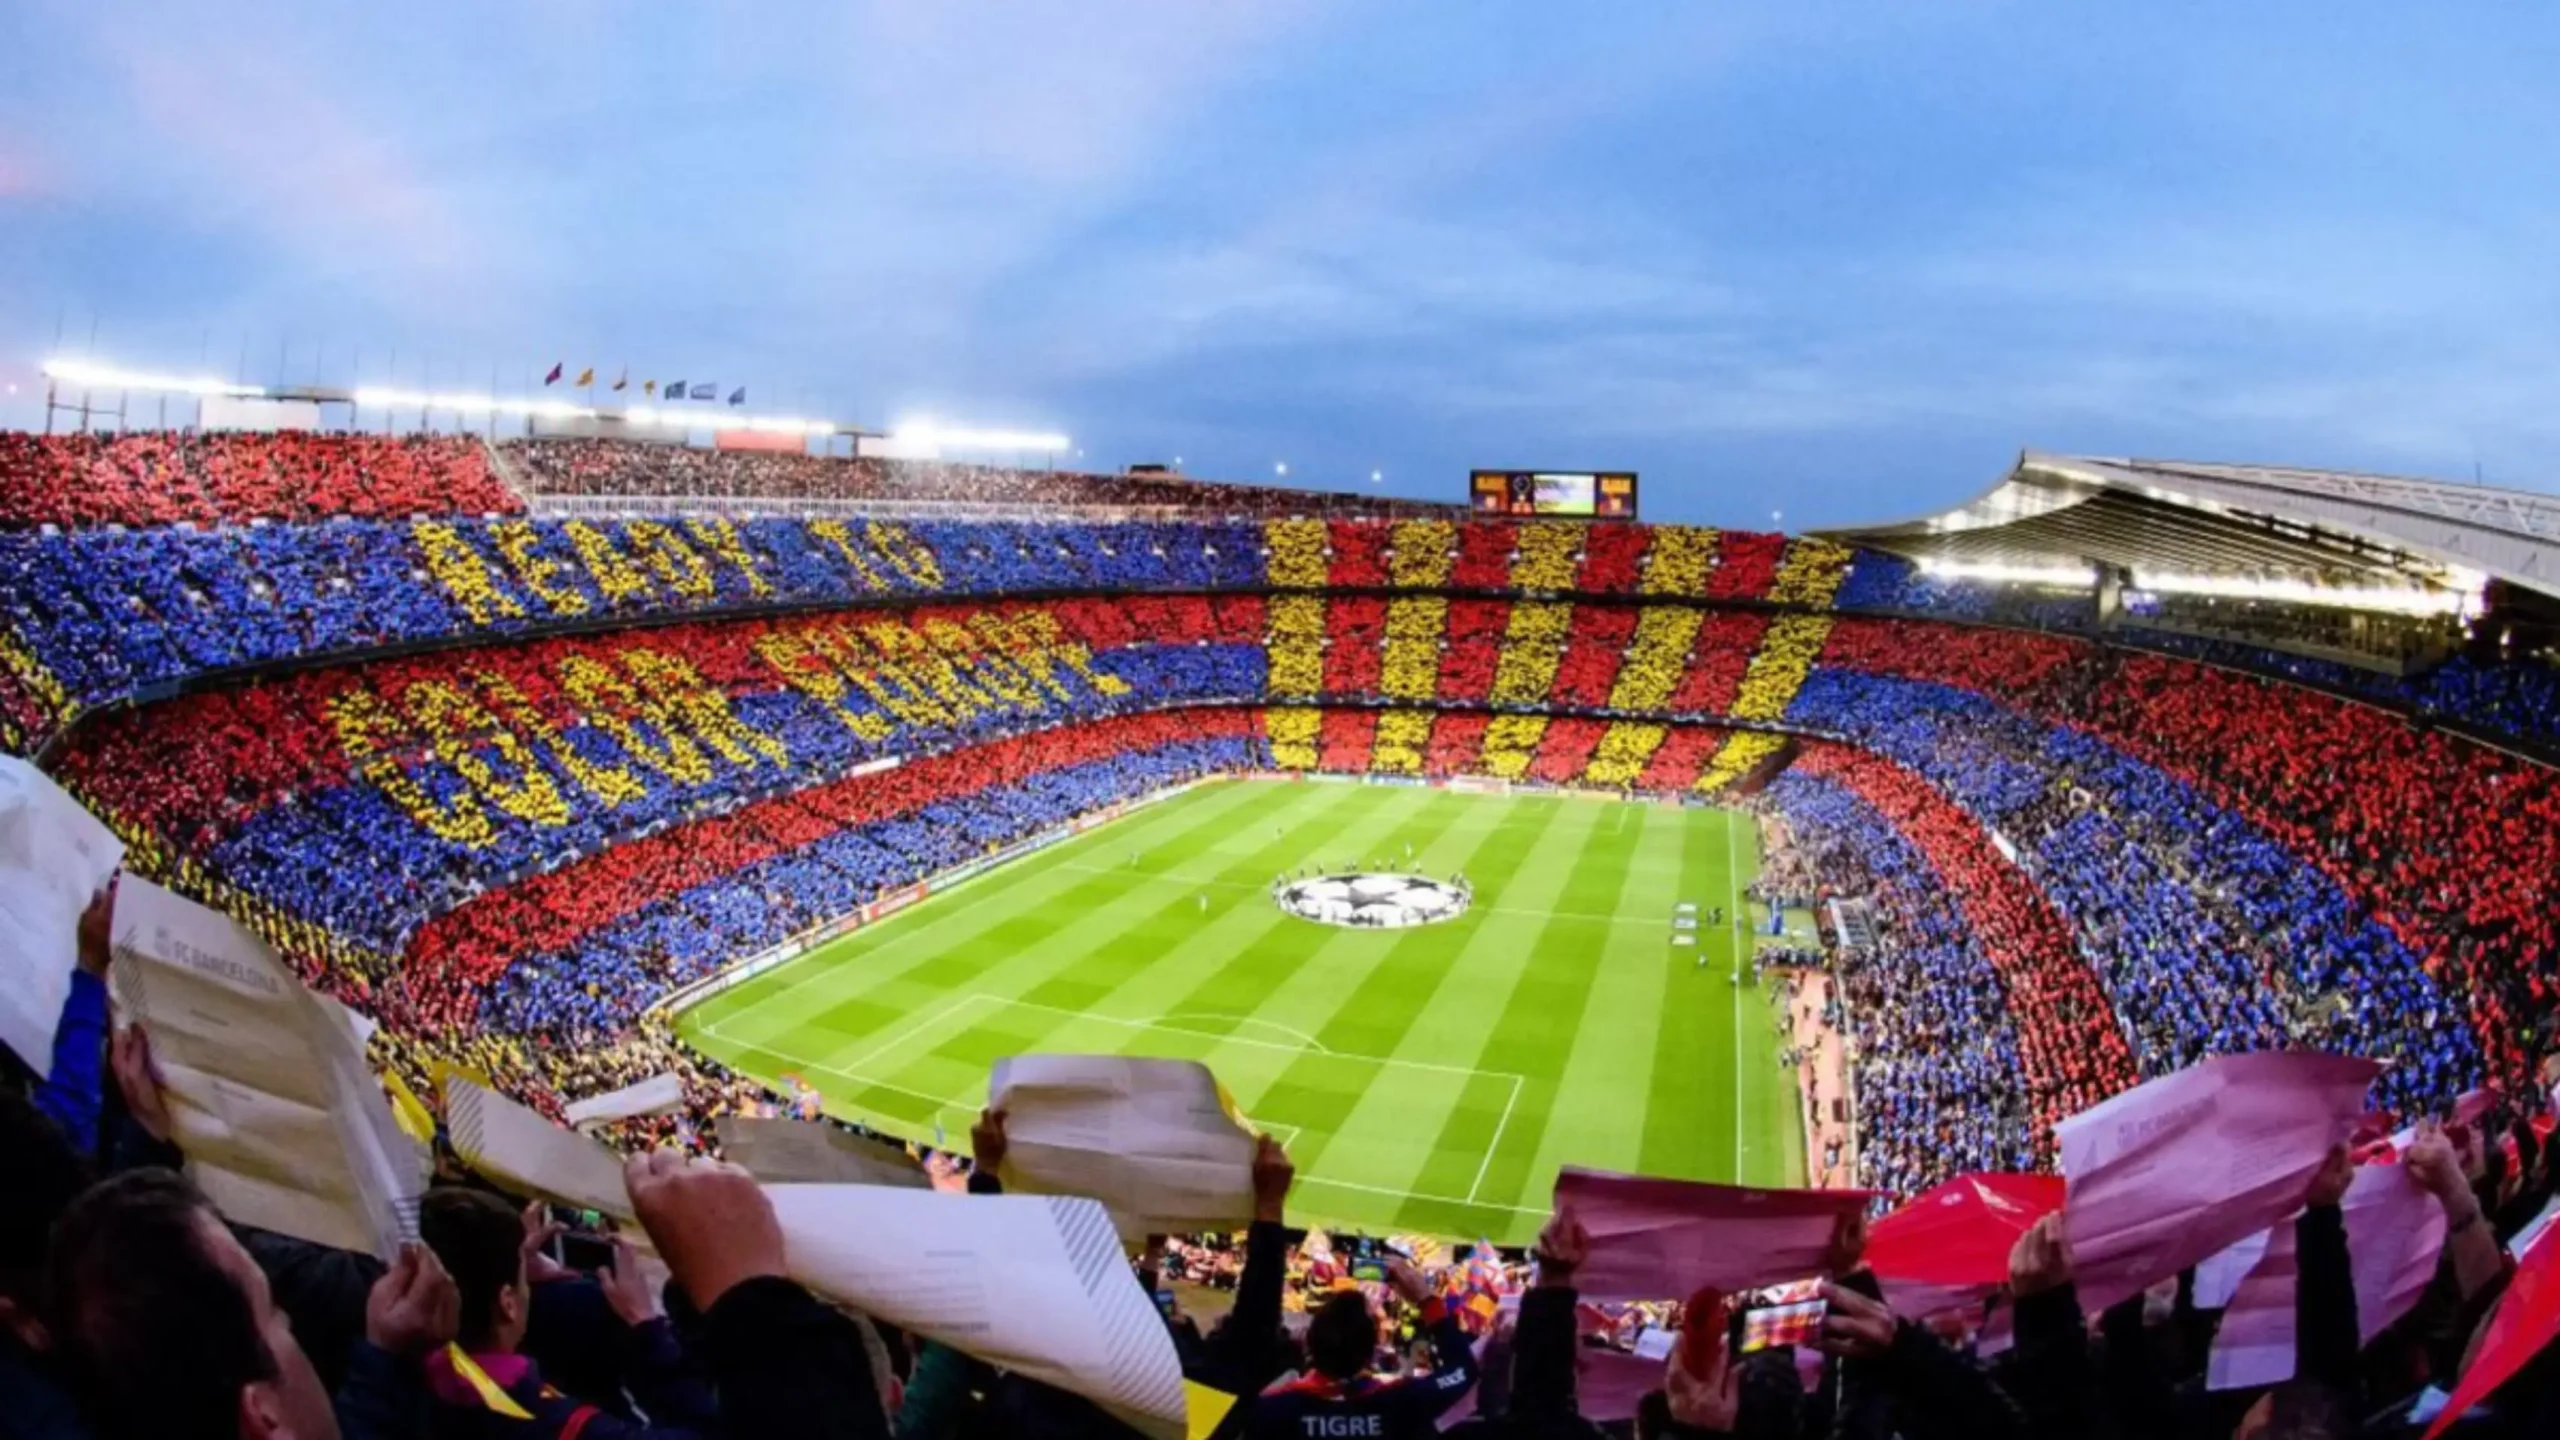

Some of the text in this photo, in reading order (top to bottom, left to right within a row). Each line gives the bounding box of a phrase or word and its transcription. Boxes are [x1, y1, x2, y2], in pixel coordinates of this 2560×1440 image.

[173, 940, 280, 994] FC BARCELONA
[1301, 1415, 1383, 1437] TIGRE
